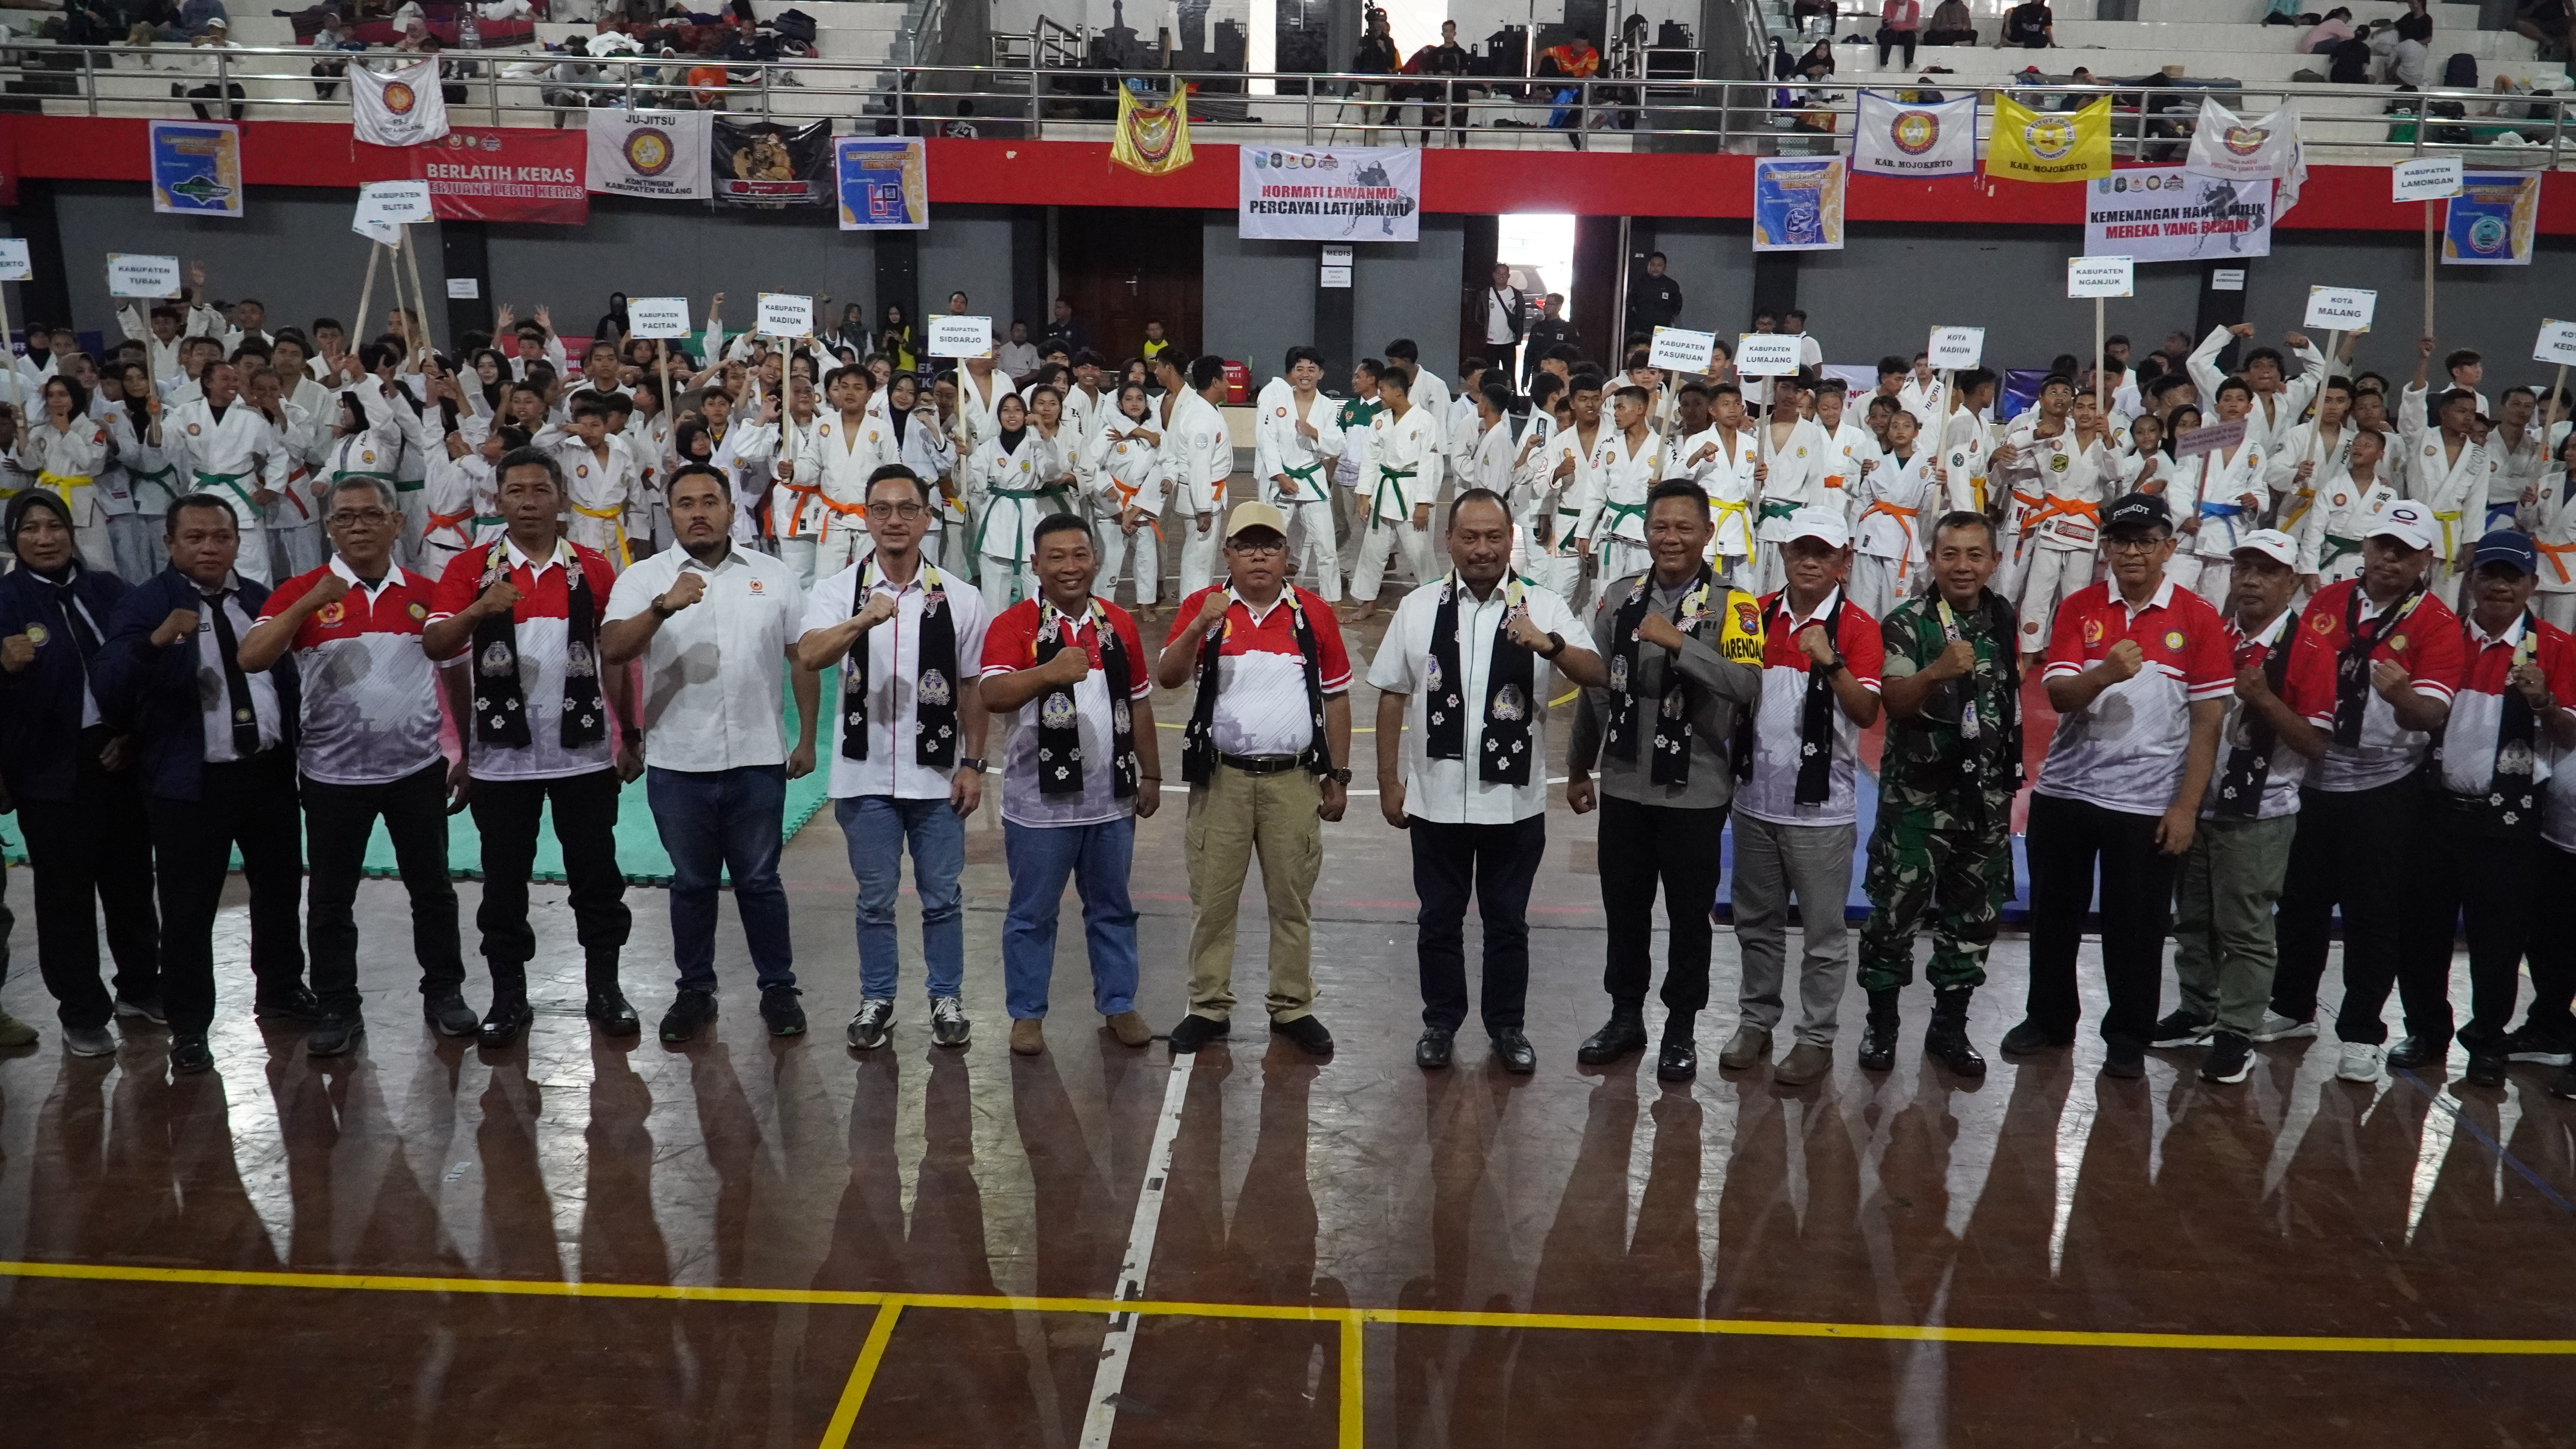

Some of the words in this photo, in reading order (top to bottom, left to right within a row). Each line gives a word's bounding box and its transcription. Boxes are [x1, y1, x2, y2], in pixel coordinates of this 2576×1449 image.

[626, 115, 675, 125] JU-JITSU
[2034, 148, 2067, 159] INDONESIA
[1875, 158, 1895, 167] KAB.
[1898, 160, 1953, 168] MOJOKERTO
[2011, 161, 2031, 170] KAB.
[2034, 163, 2087, 173] MOJOKERTO
[427, 164, 512, 181] BERLATIH
[518, 167, 575, 183] KERAS
[2404, 167, 2451, 176] KABUPATEN
[605, 182, 656, 193] KABUPATEN
[625, 178, 674, 187] KONTINGEN
[2402, 177, 2454, 188] LAMONGAN
[429, 181, 492, 196] ERJUANG
[494, 183, 535, 197] LEBIH
[538, 185, 583, 199] KERAS
[1262, 185, 1324, 198] HORMATI
[1327, 186, 1397, 200] LAWANMU
[1250, 200, 1319, 215] PERCAYAI
[1324, 202, 1409, 216] LATIHANMU
[2090, 208, 2179, 223] KEMENANGAN
[2106, 224, 2160, 239] MEREKA
[2164, 221, 2197, 236] YANG
[2201, 219, 2249, 233] BERANI
[765, 304, 806, 313] KABUPATEN
[2318, 307, 2361, 318] MALANG
[770, 316, 802, 324] MADIUN
[1660, 340, 1705, 351] KABUPATEN
[1940, 346, 1971, 354] MADIUN
[1659, 350, 1703, 361] PASURUAN
